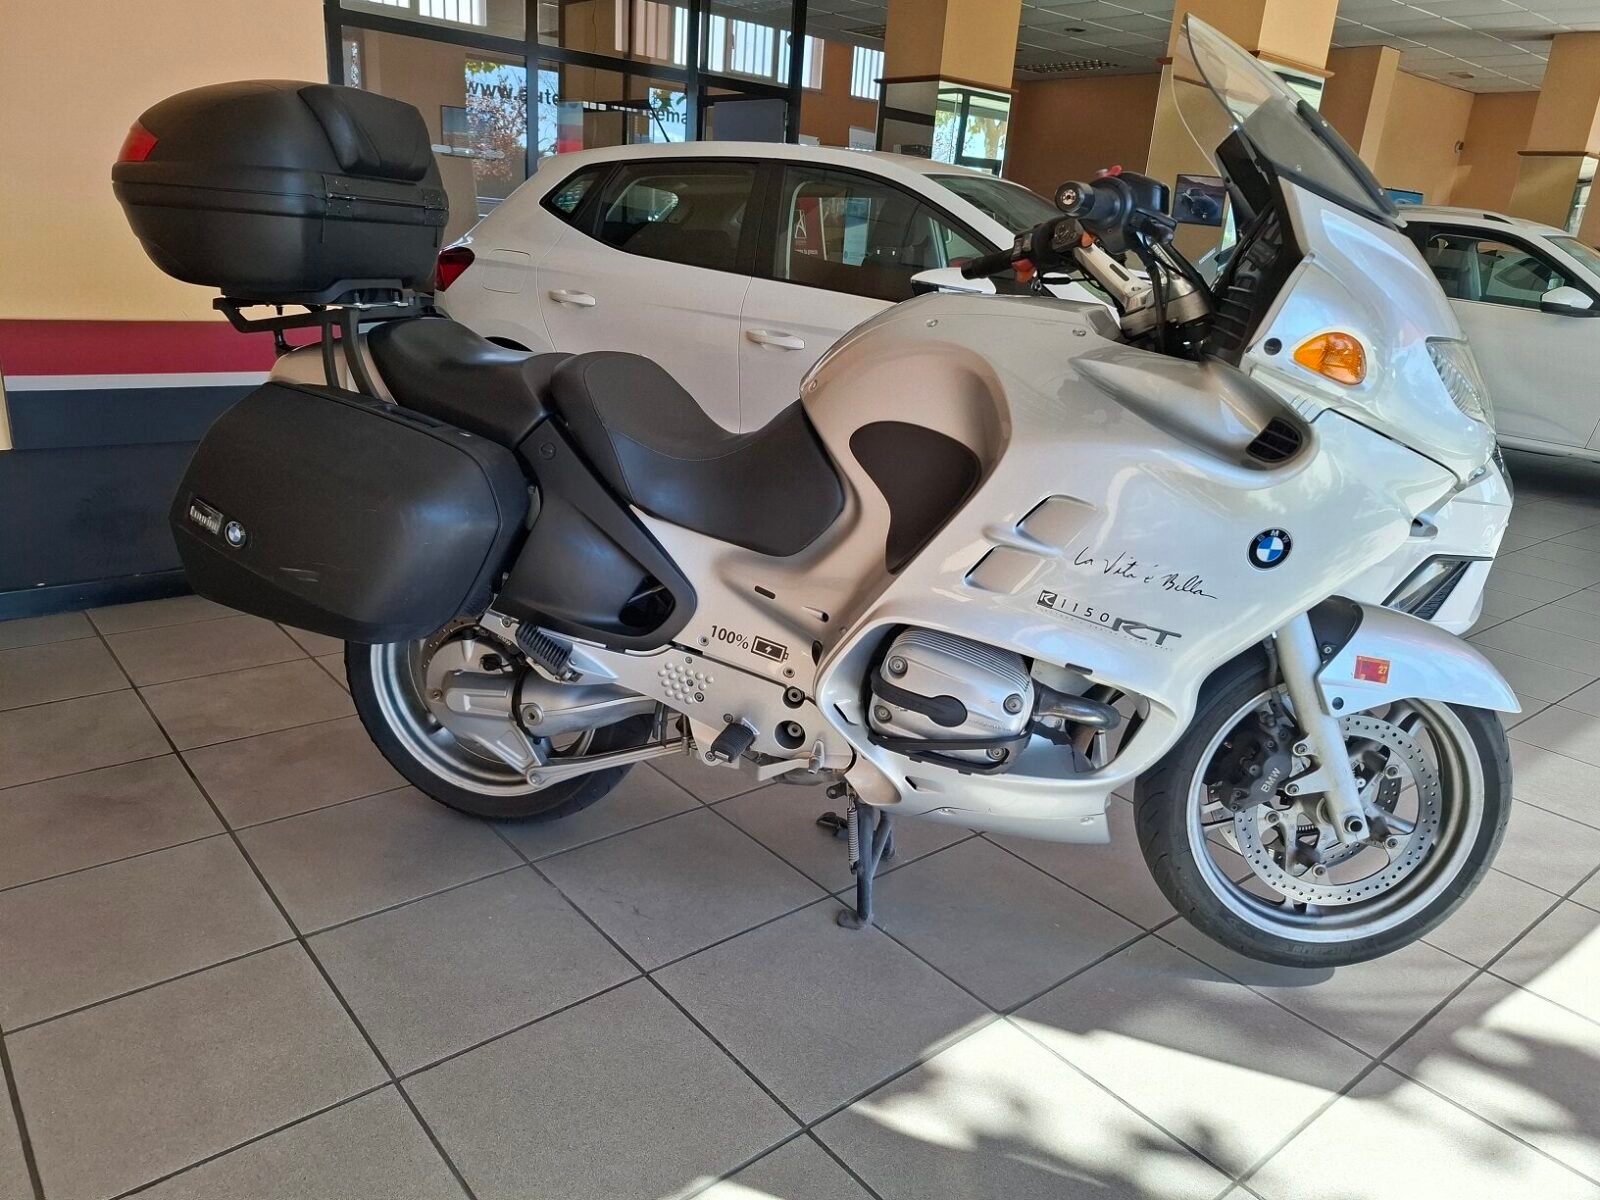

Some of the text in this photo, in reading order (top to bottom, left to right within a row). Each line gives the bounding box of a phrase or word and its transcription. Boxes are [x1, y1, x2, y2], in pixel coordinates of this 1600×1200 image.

[1104, 552, 1137, 578] Vita
[1161, 573, 1218, 599] Bella
[711, 625, 749, 650] 100%
[1260, 767, 1281, 793] BMW
